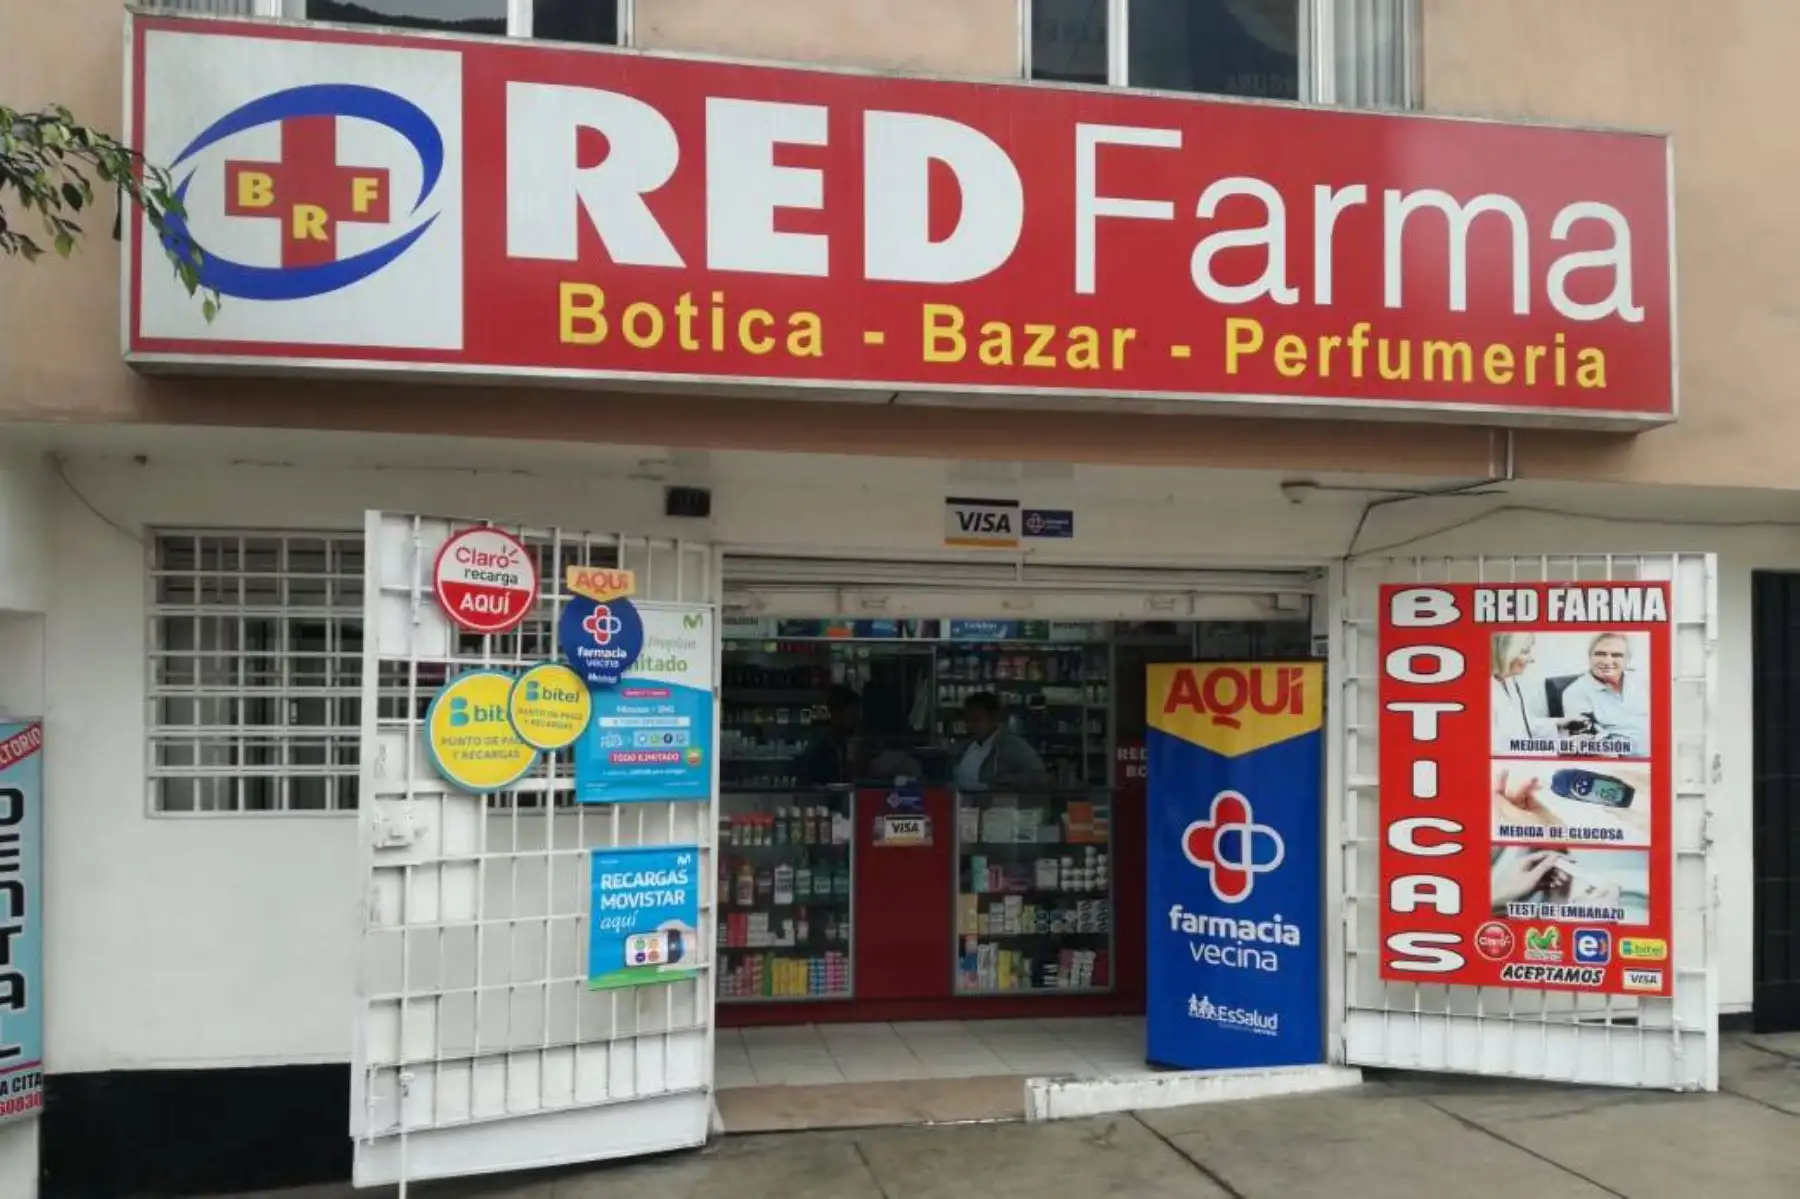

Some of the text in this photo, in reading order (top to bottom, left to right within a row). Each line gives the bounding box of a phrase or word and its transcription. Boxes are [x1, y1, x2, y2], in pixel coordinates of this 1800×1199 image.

[506, 80, 1645, 323] RED Farma
[559, 281, 823, 358] Botica
[922, 303, 1136, 371] Bazar
[1225, 317, 1608, 389] Perfumeria
[955, 511, 1012, 533] VISA
[456, 546, 510, 568] Claro
[464, 569, 518, 586] recarga
[460, 591, 511, 614] AQUÍ
[1474, 587, 1668, 622] RED FARMA
[577, 646, 628, 659] farmacia
[543, 686, 580, 703] bitel
[474, 705, 505, 722] bit
[1510, 739, 1555, 751] MEDIDA
[1560, 741, 1574, 751] DE
[1385, 588, 1466, 972] BOTICAS
[891, 822, 919, 834] VISA
[1500, 825, 1624, 840] MEDIDA DE GLUCOSA
[601, 869, 689, 890] RECARGAS
[600, 890, 685, 910] MOVISTAR
[1509, 904, 1625, 919] TEST DE EMBARAZO
[1168, 904, 1300, 946] farmacia
[1189, 940, 1278, 972] vecina
[1502, 964, 1603, 984] ACEPTAMOS
[1218, 1005, 1278, 1030] EsSalud
[12, 1071, 42, 1092] CITA
